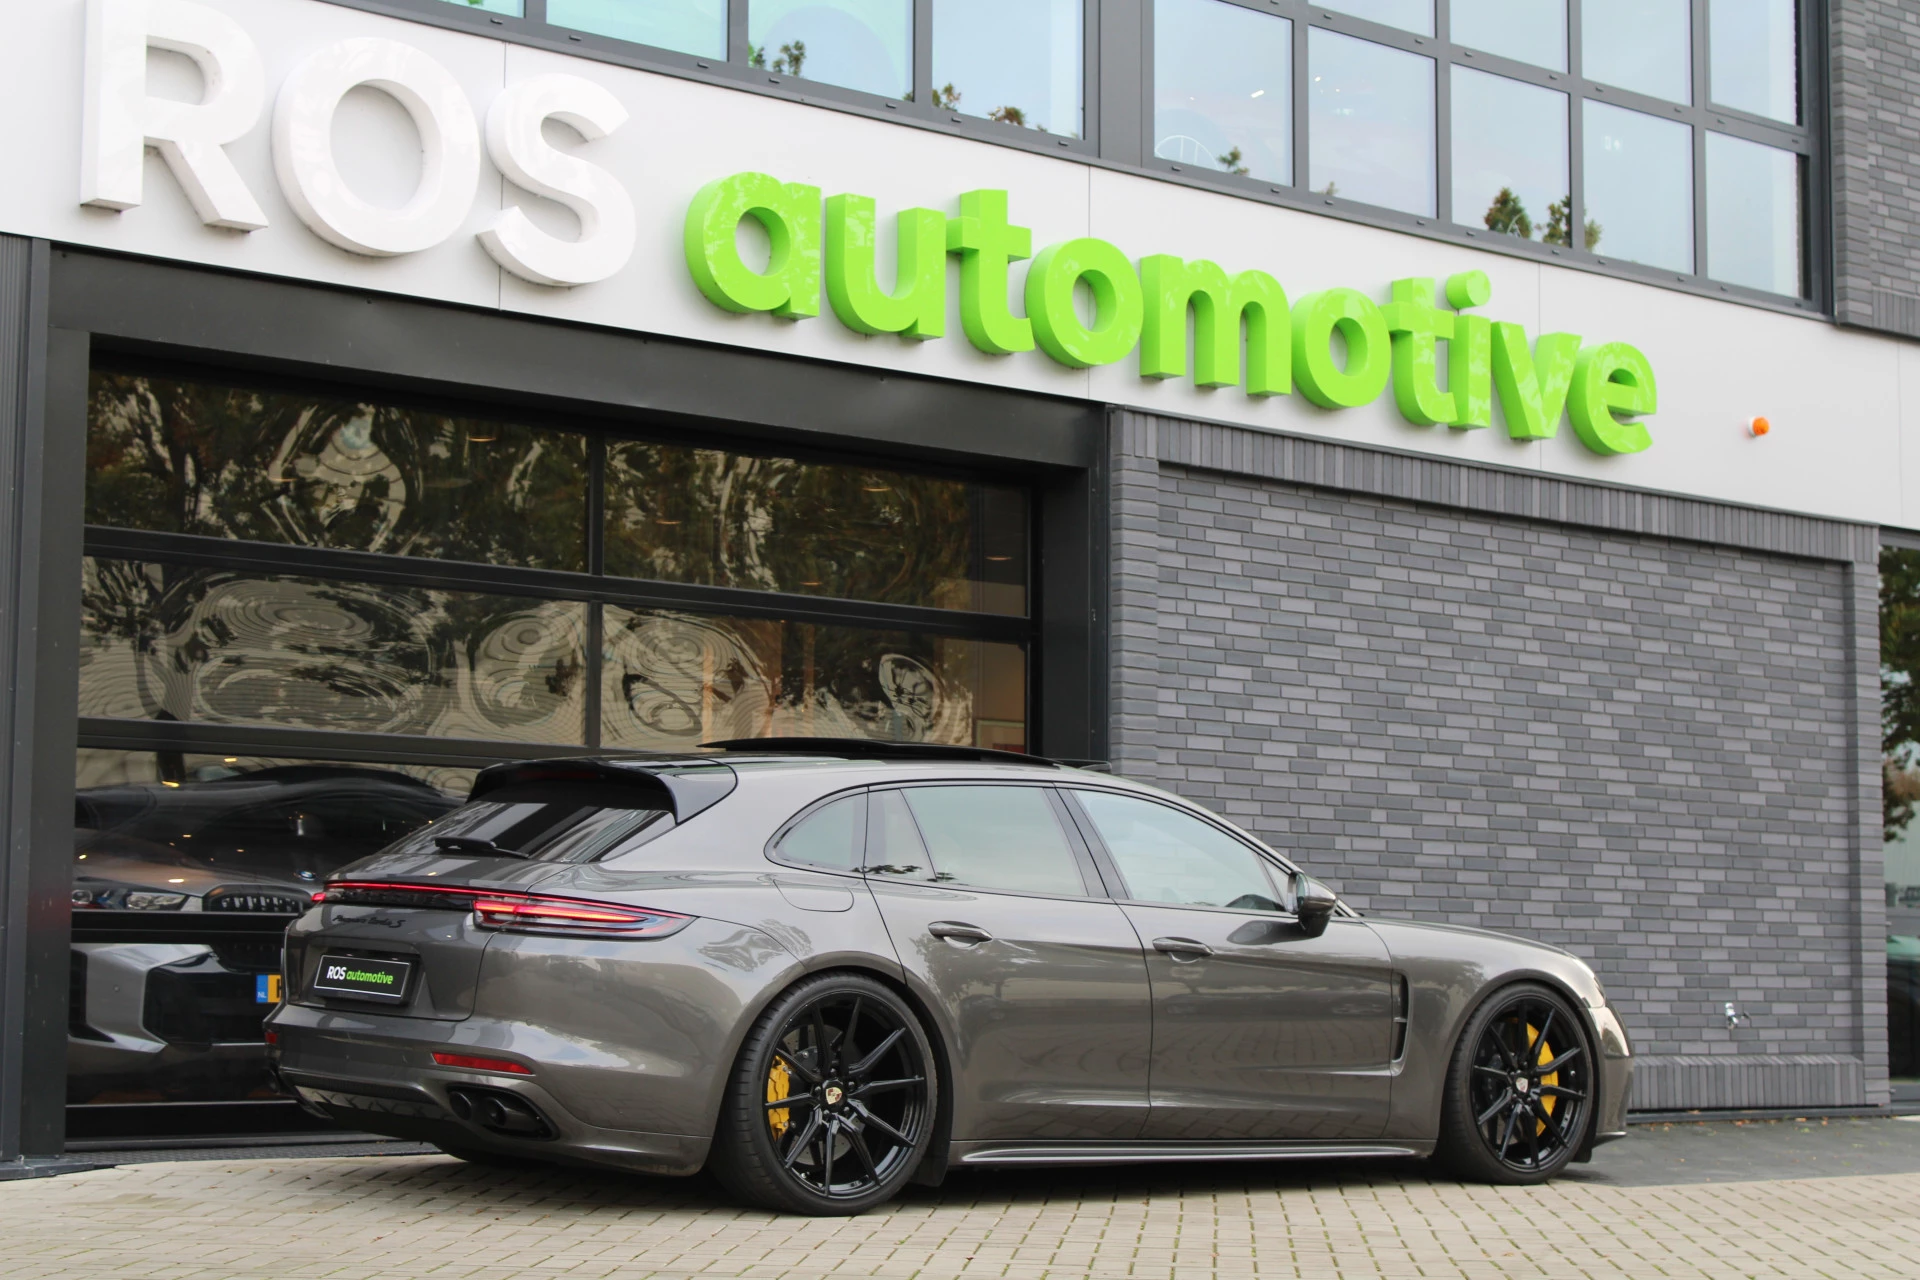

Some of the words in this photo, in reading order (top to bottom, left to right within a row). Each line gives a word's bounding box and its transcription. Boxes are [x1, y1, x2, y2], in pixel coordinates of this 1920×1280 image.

[80, 0, 636, 287] ROS
[684, 171, 1657, 456] automotive
[327, 965, 347, 980] ROS
[346, 970, 394, 984] automotive
